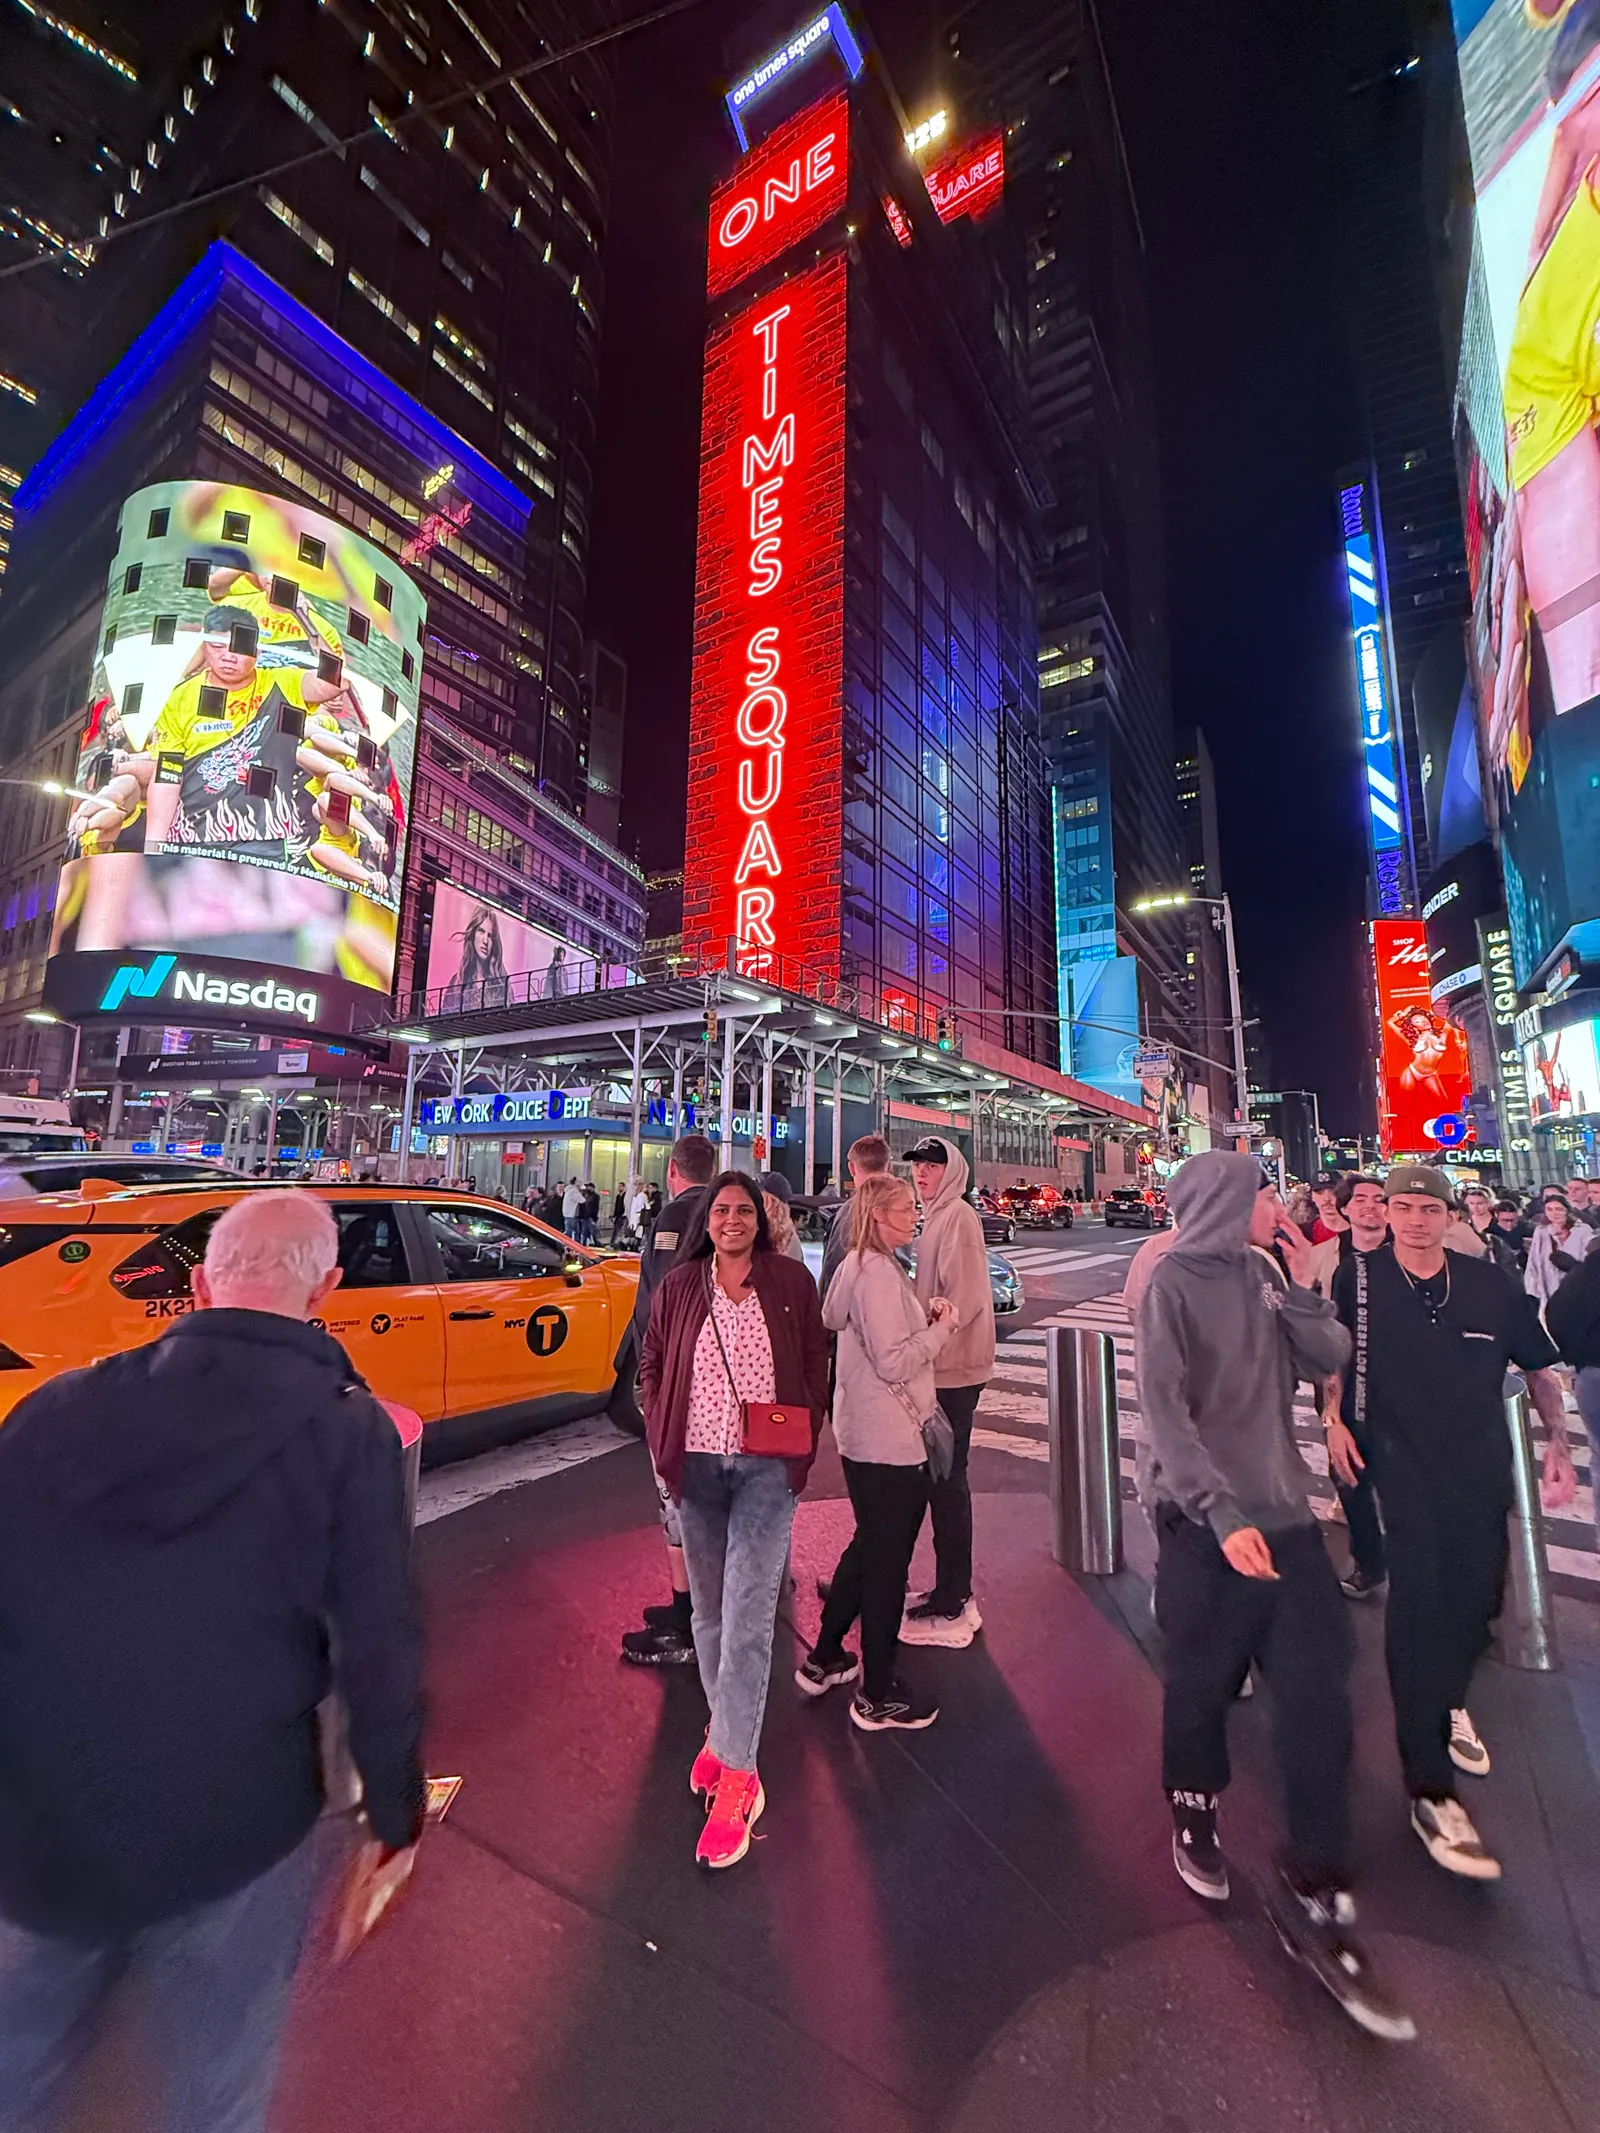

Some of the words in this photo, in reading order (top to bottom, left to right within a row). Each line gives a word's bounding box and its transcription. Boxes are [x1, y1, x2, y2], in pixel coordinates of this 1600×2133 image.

[733, 79, 756, 105] one
[754, 51, 788, 87] times
[787, 16, 830, 60] square
[718, 132, 837, 249] ONE
[741, 304, 796, 598] TIMES
[157, 842, 180, 854] This
[180, 846, 226, 860] material
[227, 850, 238, 861] is
[238, 853, 286, 871] prepared
[287, 861, 299, 874] by
[349, 881, 360, 892] TV
[1392, 938, 1415, 946] SHOP
[173, 970, 318, 1023] Nasdaq
[1438, 976, 1459, 994] CHASE
[1487, 928, 1517, 1026] SQUARE
[1515, 1003, 1543, 1046] AT&T
[420, 1098, 453, 1125] NEW
[454, 1097, 490, 1124] YORK
[493, 1093, 543, 1123] POLICE
[547, 1090, 592, 1120] DEPT
[1500, 1048, 1531, 1124] TIMES
[1445, 1148, 1503, 1164] CHASE
[1510, 1138, 1531, 1152] 3
[145, 1299, 195, 1318] 2K21
[503, 1318, 526, 1329] NYC
[536, 1315, 560, 1350] T
